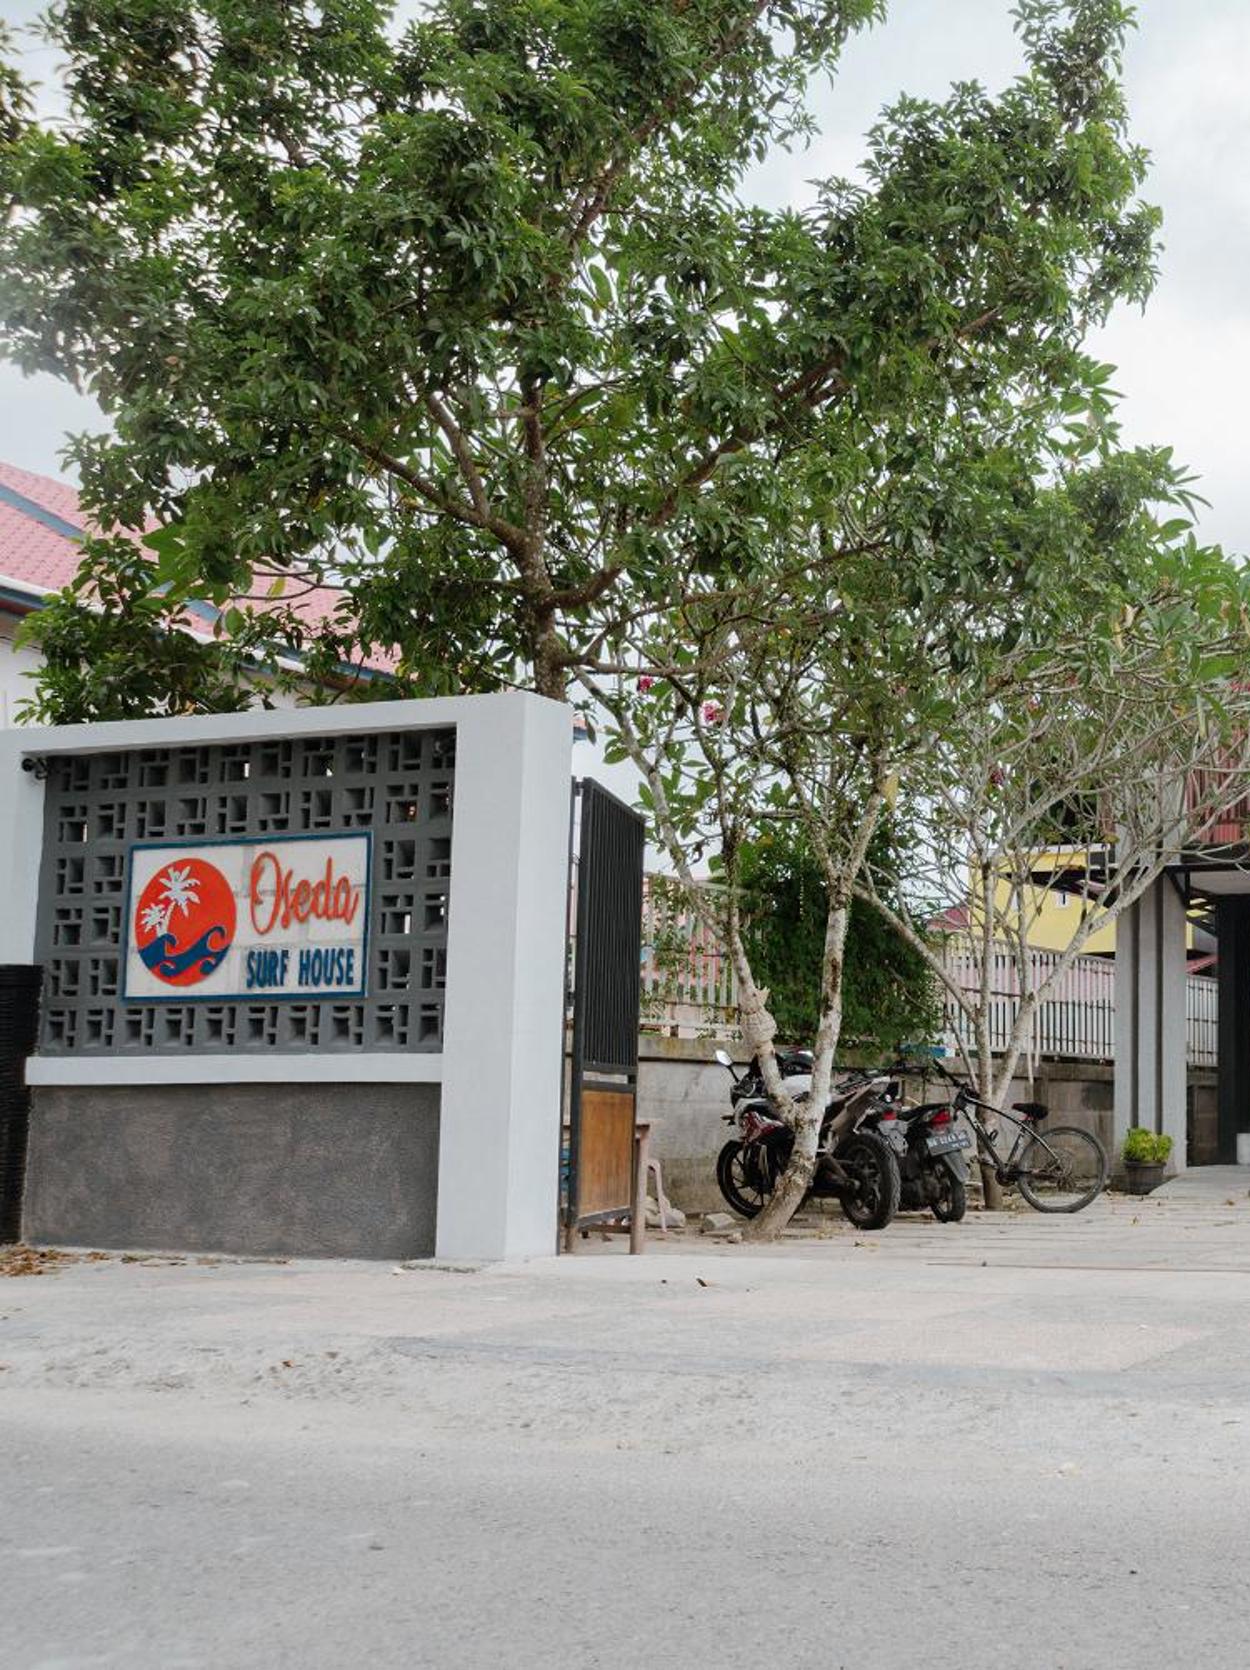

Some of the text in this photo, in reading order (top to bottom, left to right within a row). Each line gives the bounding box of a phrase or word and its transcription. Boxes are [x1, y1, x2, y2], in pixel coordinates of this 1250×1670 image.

[250, 852, 359, 935] Oseda
[246, 949, 354, 988] SURF HOUSE
